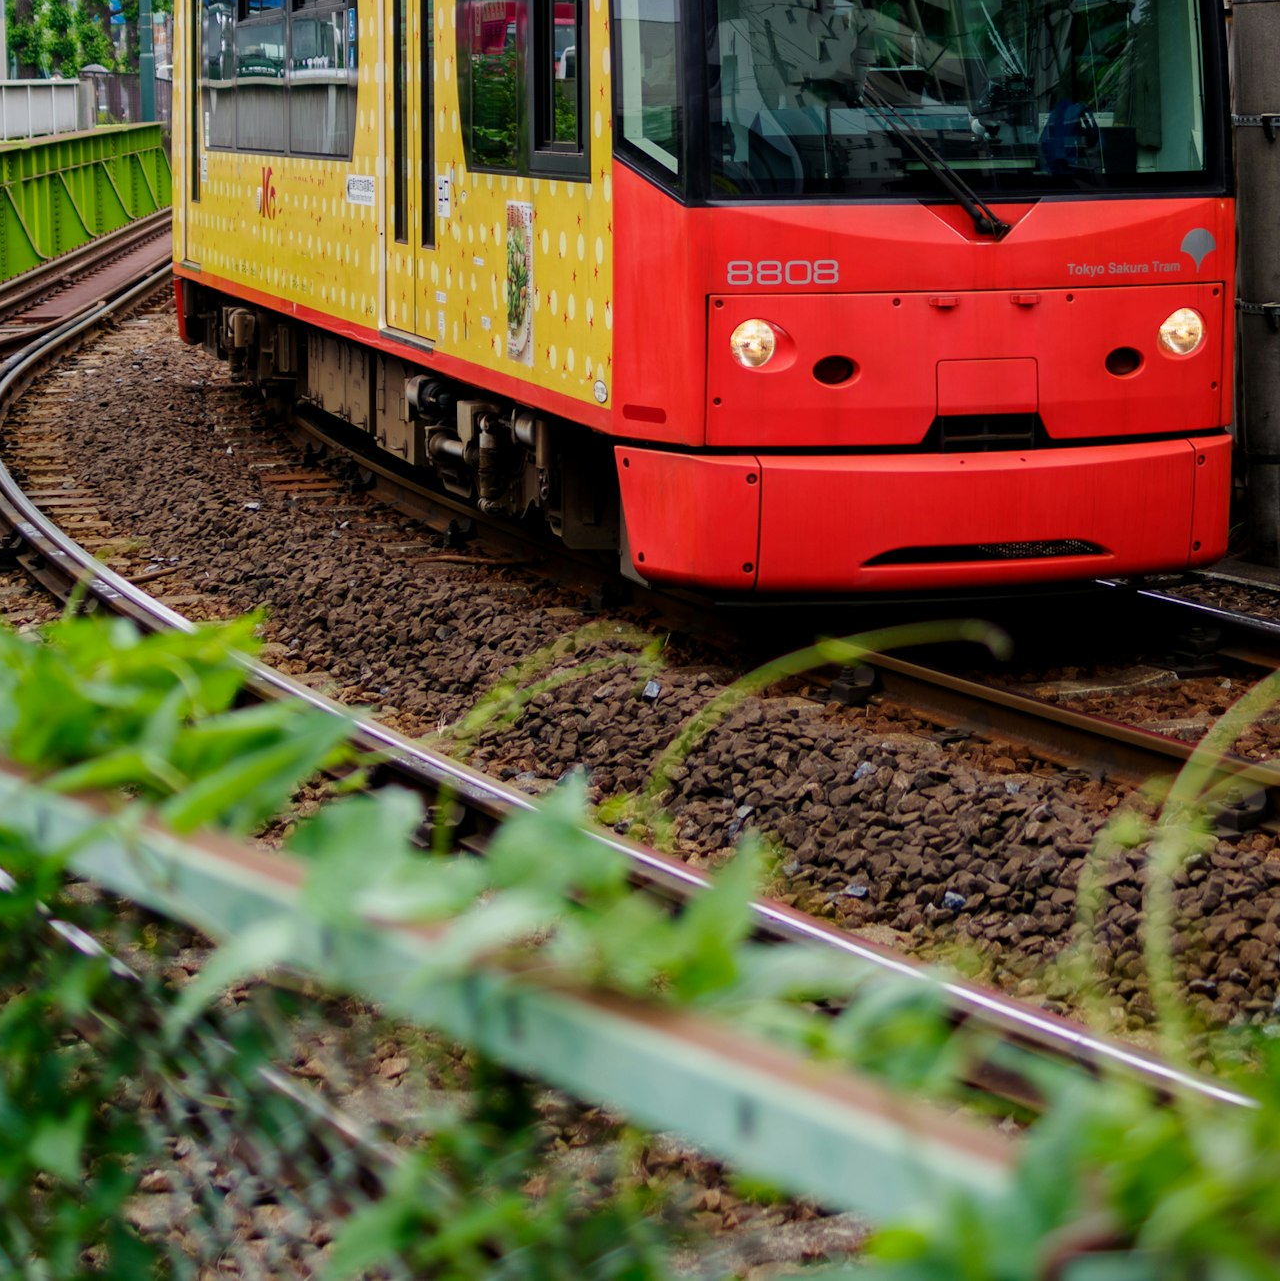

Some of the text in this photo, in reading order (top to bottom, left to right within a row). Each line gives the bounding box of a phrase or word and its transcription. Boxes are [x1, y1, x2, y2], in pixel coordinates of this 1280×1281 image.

[727, 259, 840, 285] 8808
[1067, 261, 1181, 278] Tokyo Sakura Tram
